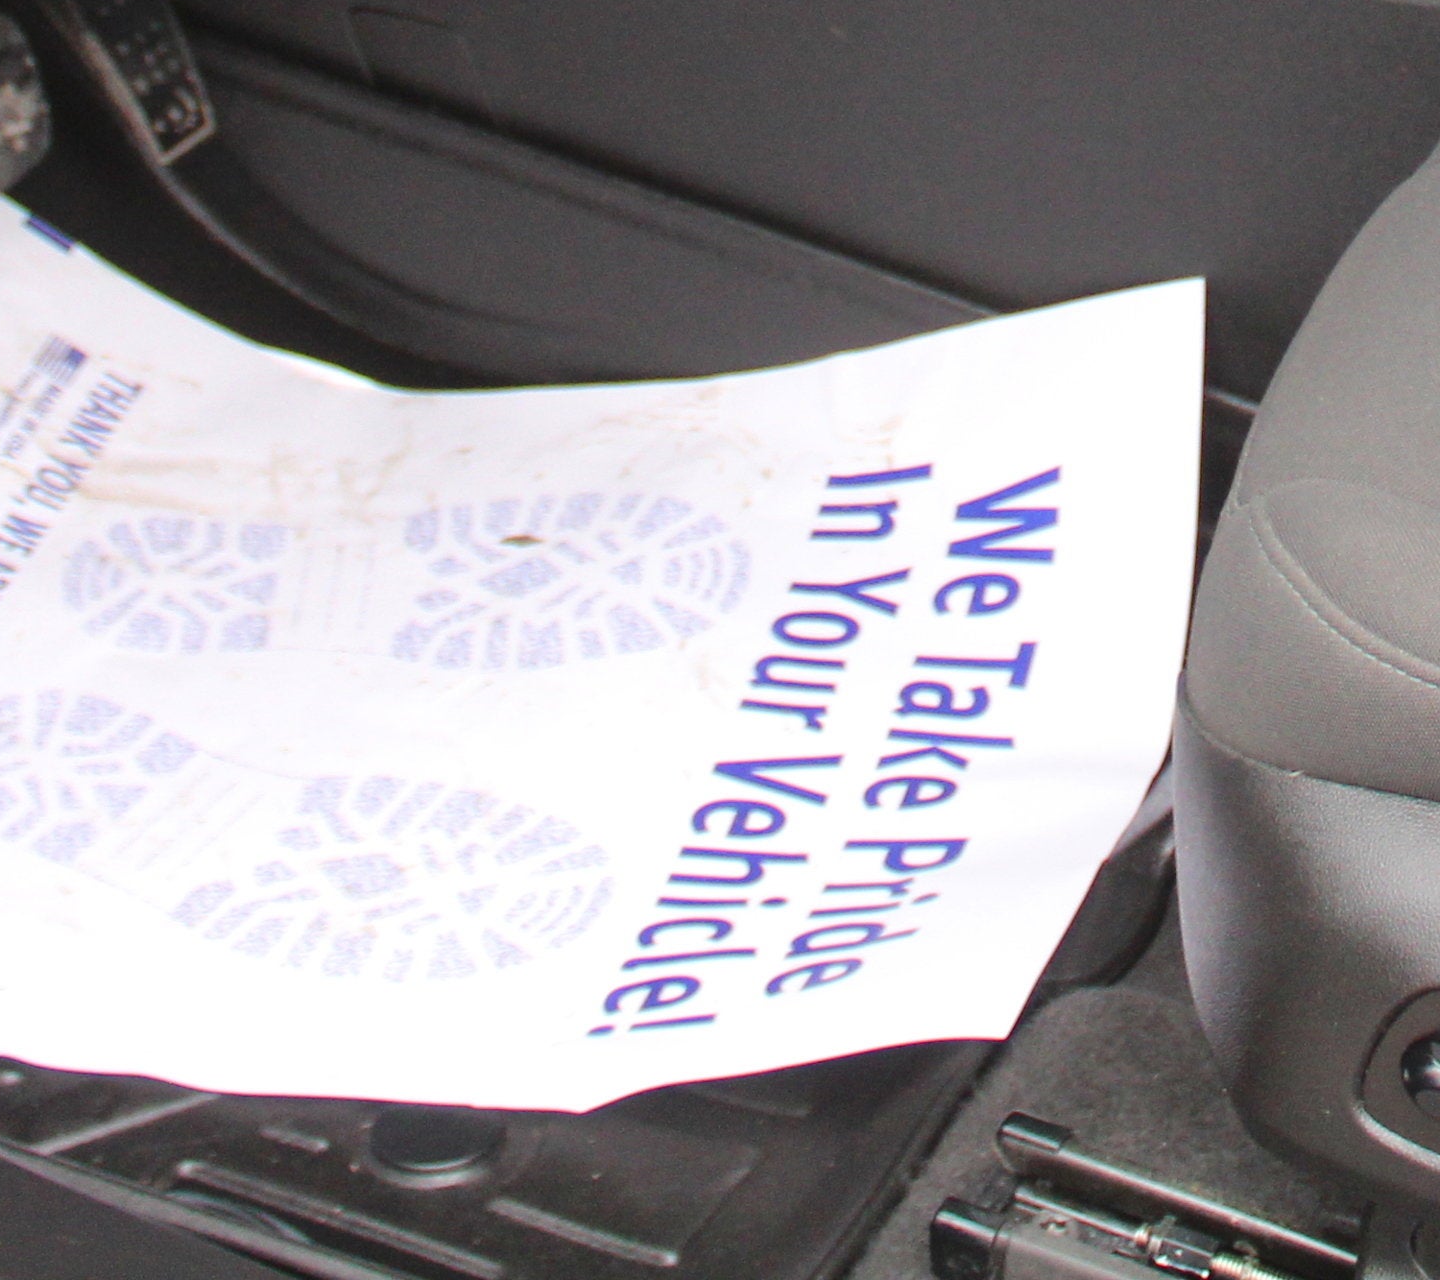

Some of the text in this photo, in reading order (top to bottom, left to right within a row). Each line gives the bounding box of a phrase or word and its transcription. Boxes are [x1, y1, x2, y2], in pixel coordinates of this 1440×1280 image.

[11, 453, 93, 511] YOU,
[58, 372, 144, 459] THANK
[587, 463, 933, 1036] In Your Vehicle!
[765, 464, 1061, 996] We Take Pride
